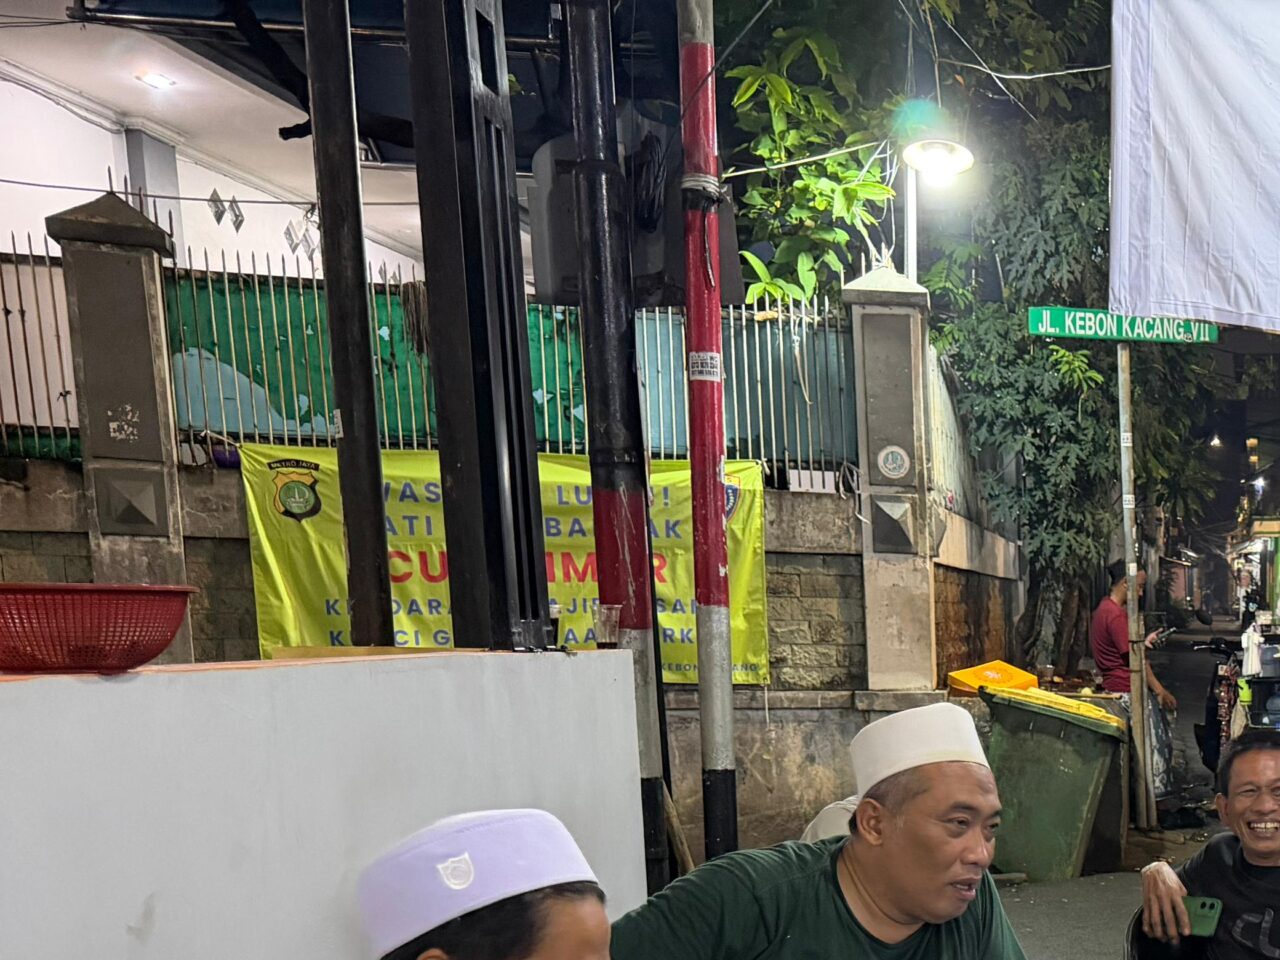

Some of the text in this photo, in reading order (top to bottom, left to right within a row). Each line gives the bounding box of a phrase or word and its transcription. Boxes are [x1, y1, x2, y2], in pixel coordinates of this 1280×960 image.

[1038, 310, 1210, 341] JL. KEBON KACANG VII
